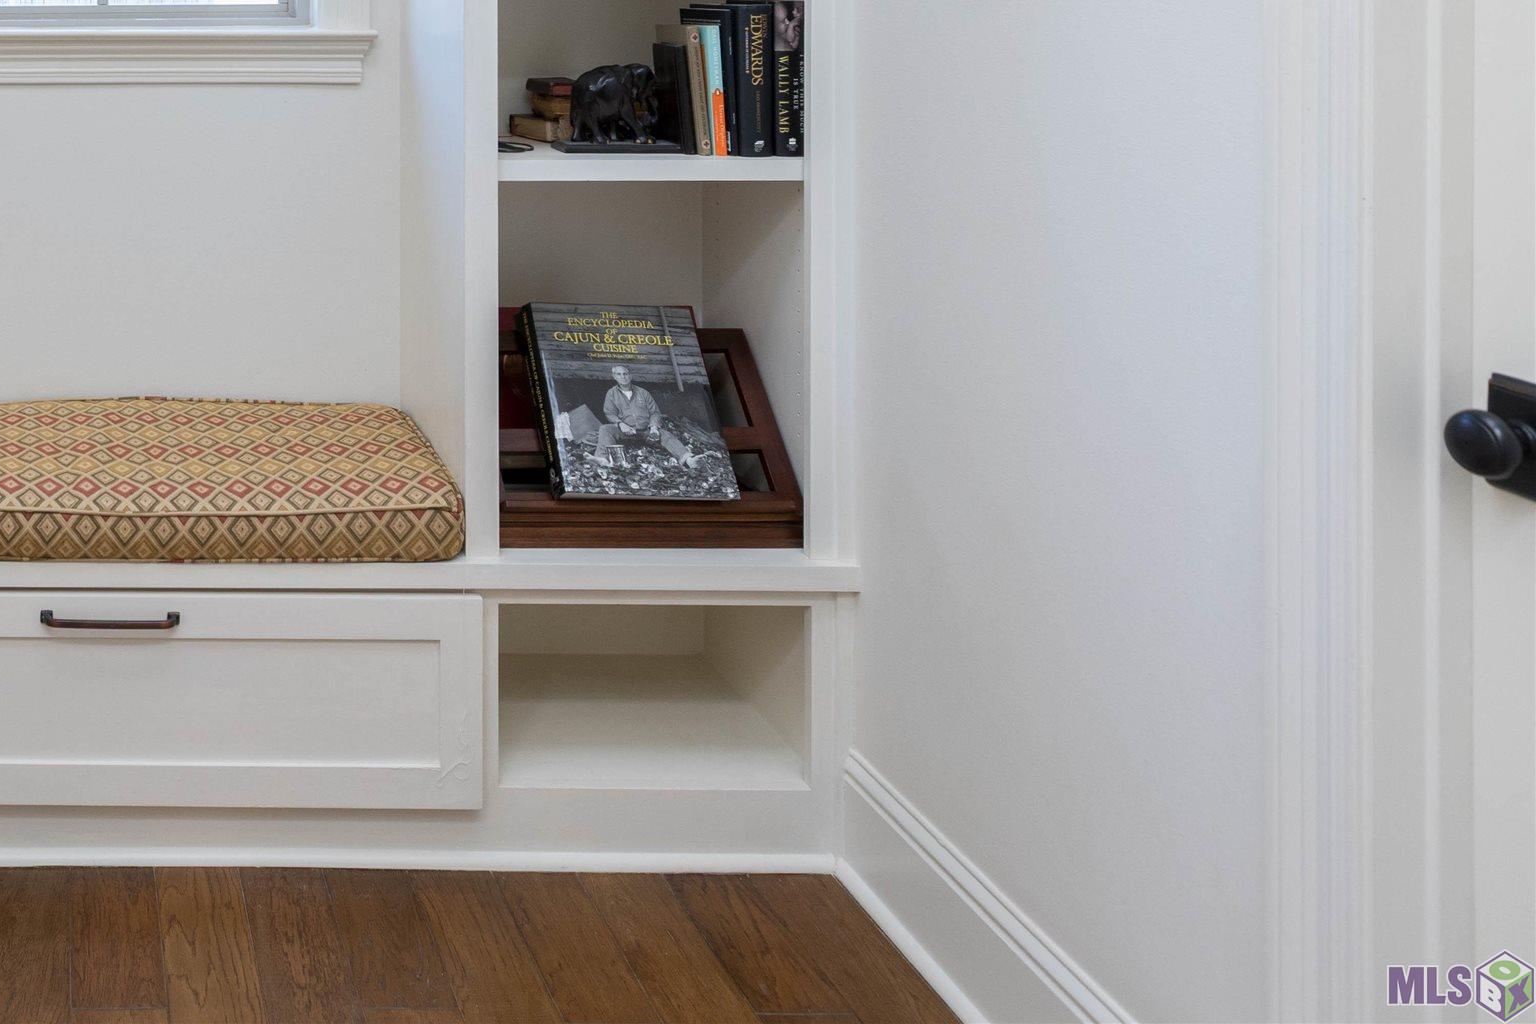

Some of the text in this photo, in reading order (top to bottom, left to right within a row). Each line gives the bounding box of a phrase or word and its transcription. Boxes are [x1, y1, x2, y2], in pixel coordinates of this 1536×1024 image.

[750, 14, 764, 85] EDWARDS
[793, 78, 799, 86] IS
[778, 55, 790, 134] WALLY LAMB
[566, 318, 654, 328] ENCYCLOPEDIA
[554, 331, 673, 346] CAJUN & CREOLE
[593, 343, 639, 353] CUISINE
